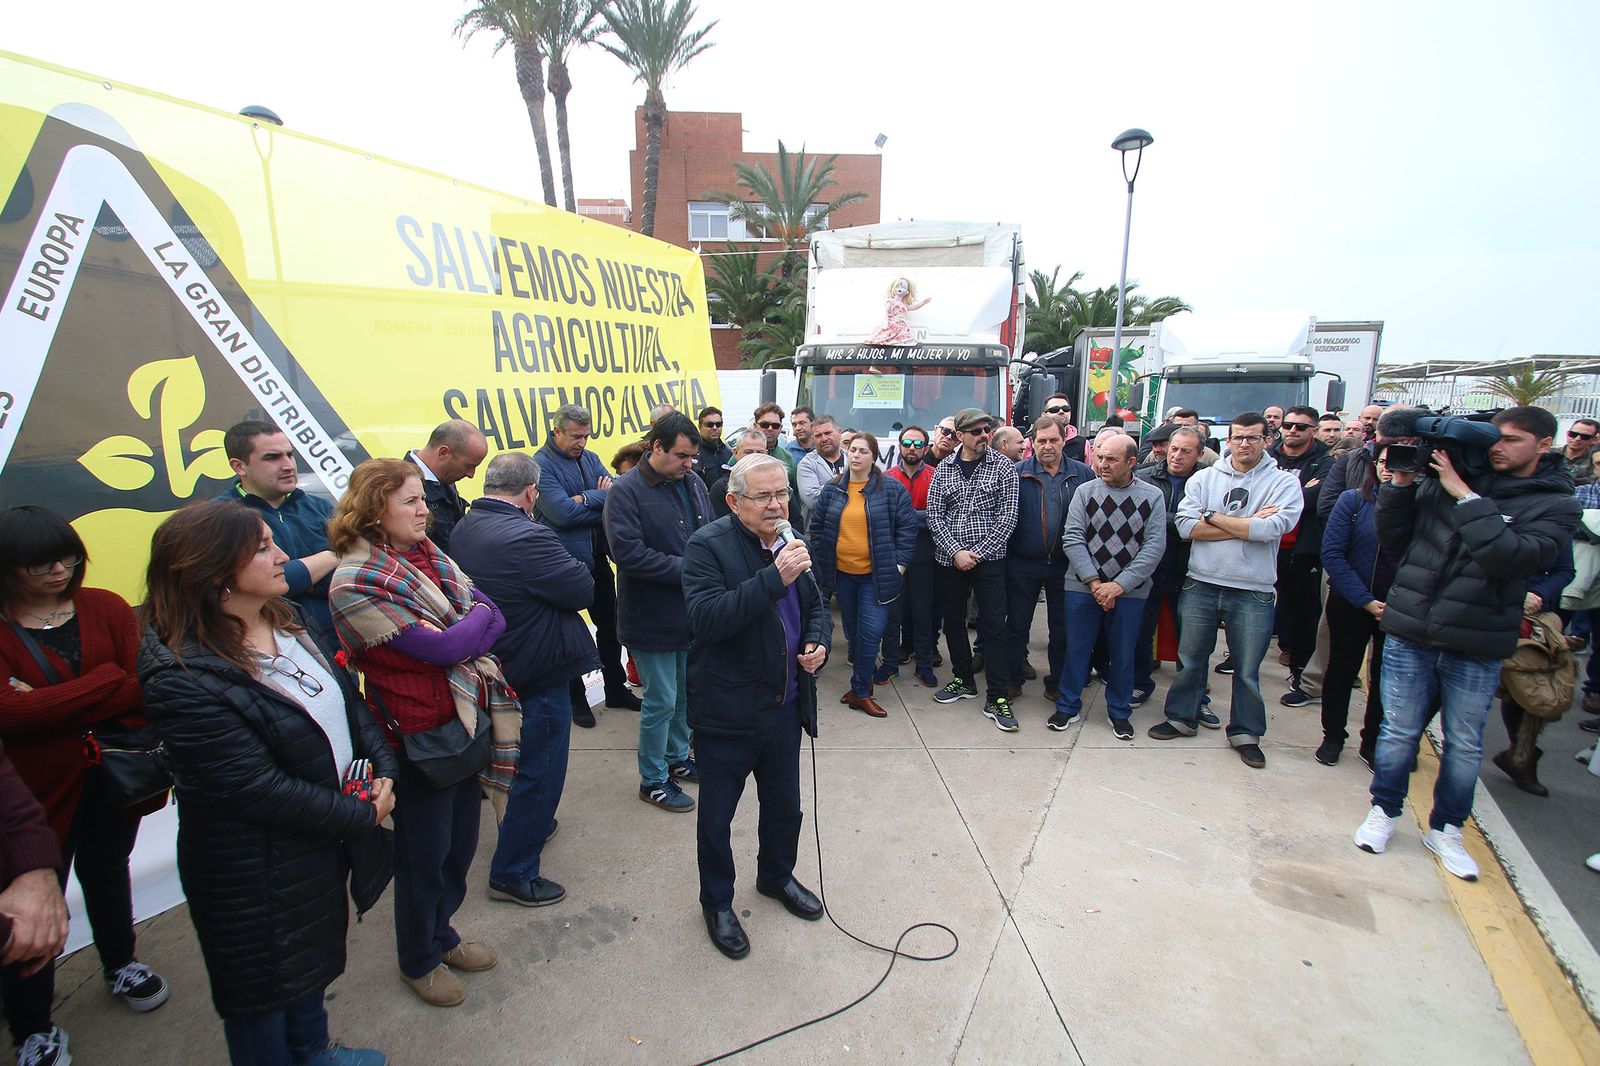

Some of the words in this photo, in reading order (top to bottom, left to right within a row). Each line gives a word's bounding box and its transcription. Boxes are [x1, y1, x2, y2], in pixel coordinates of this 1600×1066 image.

[16, 212, 85, 321] EUROPA
[396, 214, 596, 307] SALVEMOS
[596, 257, 695, 317] NUESTRA
[153, 241, 189, 280] LA
[185, 282, 248, 354] GRAN
[240, 355, 350, 490] DISTRIBUCIO
[492, 310, 680, 374] AGRICULTURA,
[826, 348, 844, 360] MIS
[846, 348, 855, 360] 2
[890, 348, 904, 360] MI
[907, 348, 942, 360] MUJER
[945, 348, 955, 360] Y
[957, 348, 971, 361] YO
[1323, 337, 1360, 345] MALDONADO
